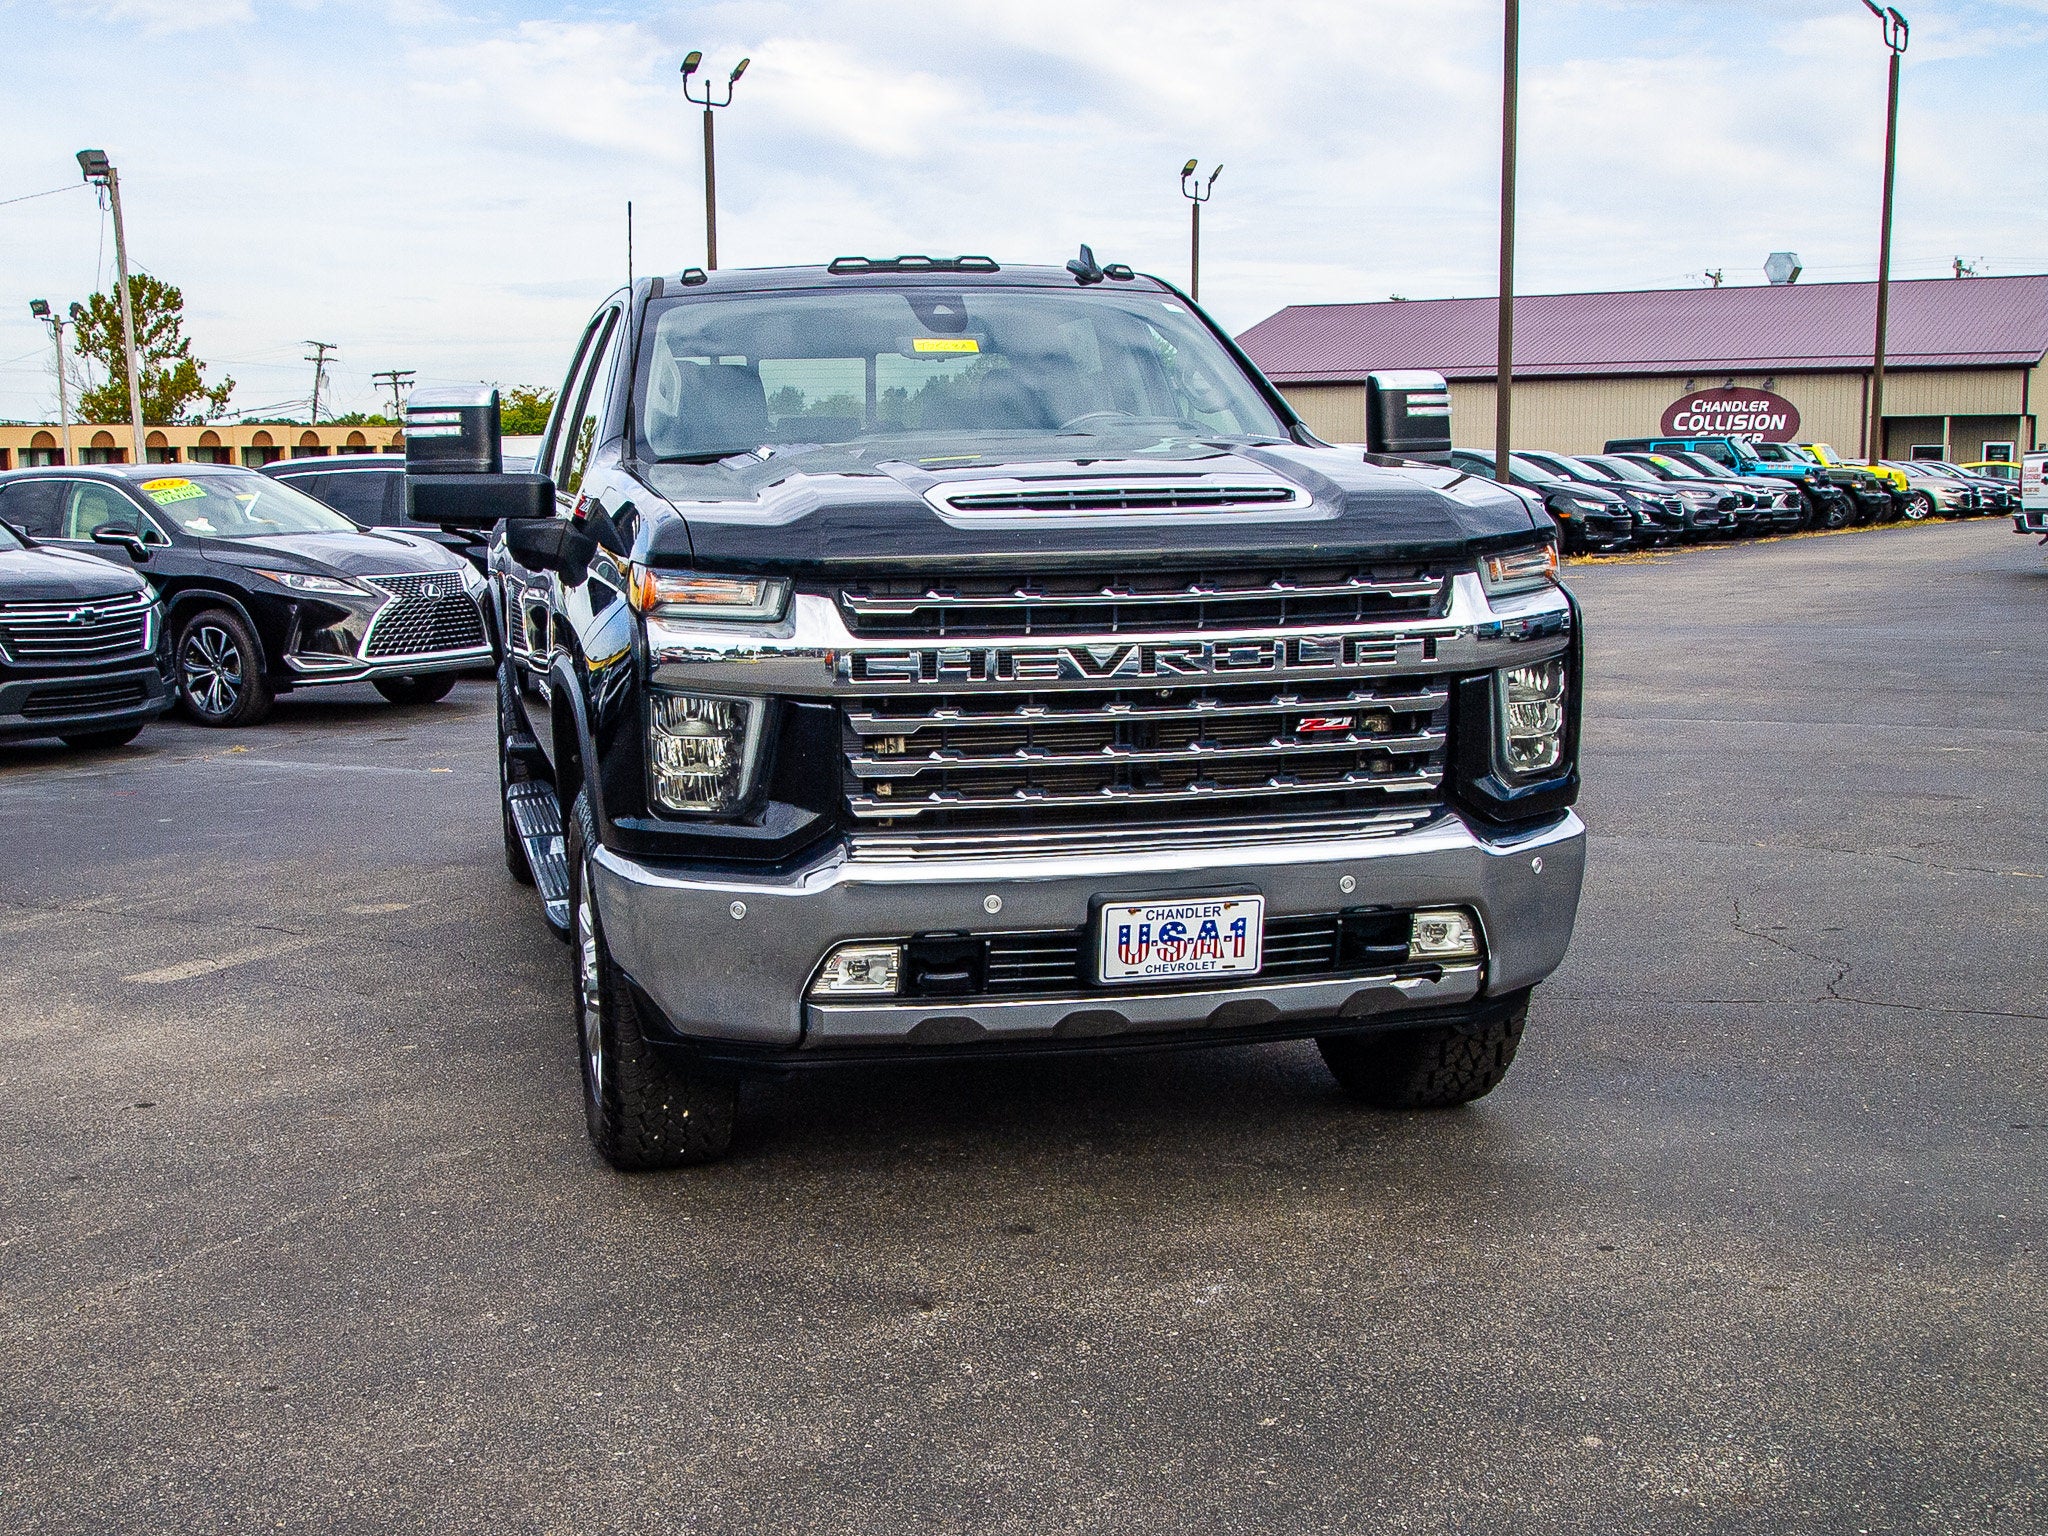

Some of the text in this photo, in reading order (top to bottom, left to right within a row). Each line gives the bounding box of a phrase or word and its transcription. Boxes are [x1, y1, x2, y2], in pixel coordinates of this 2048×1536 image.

[1691, 399, 1769, 412] CHANDLER
[1673, 412, 1787, 431] COLLISION
[849, 629, 1459, 684] CHEVROLET
[1295, 716, 1353, 732] Z71
[1145, 905, 1222, 921] CHANDLER
[1145, 960, 1217, 974] CHEVROLET
